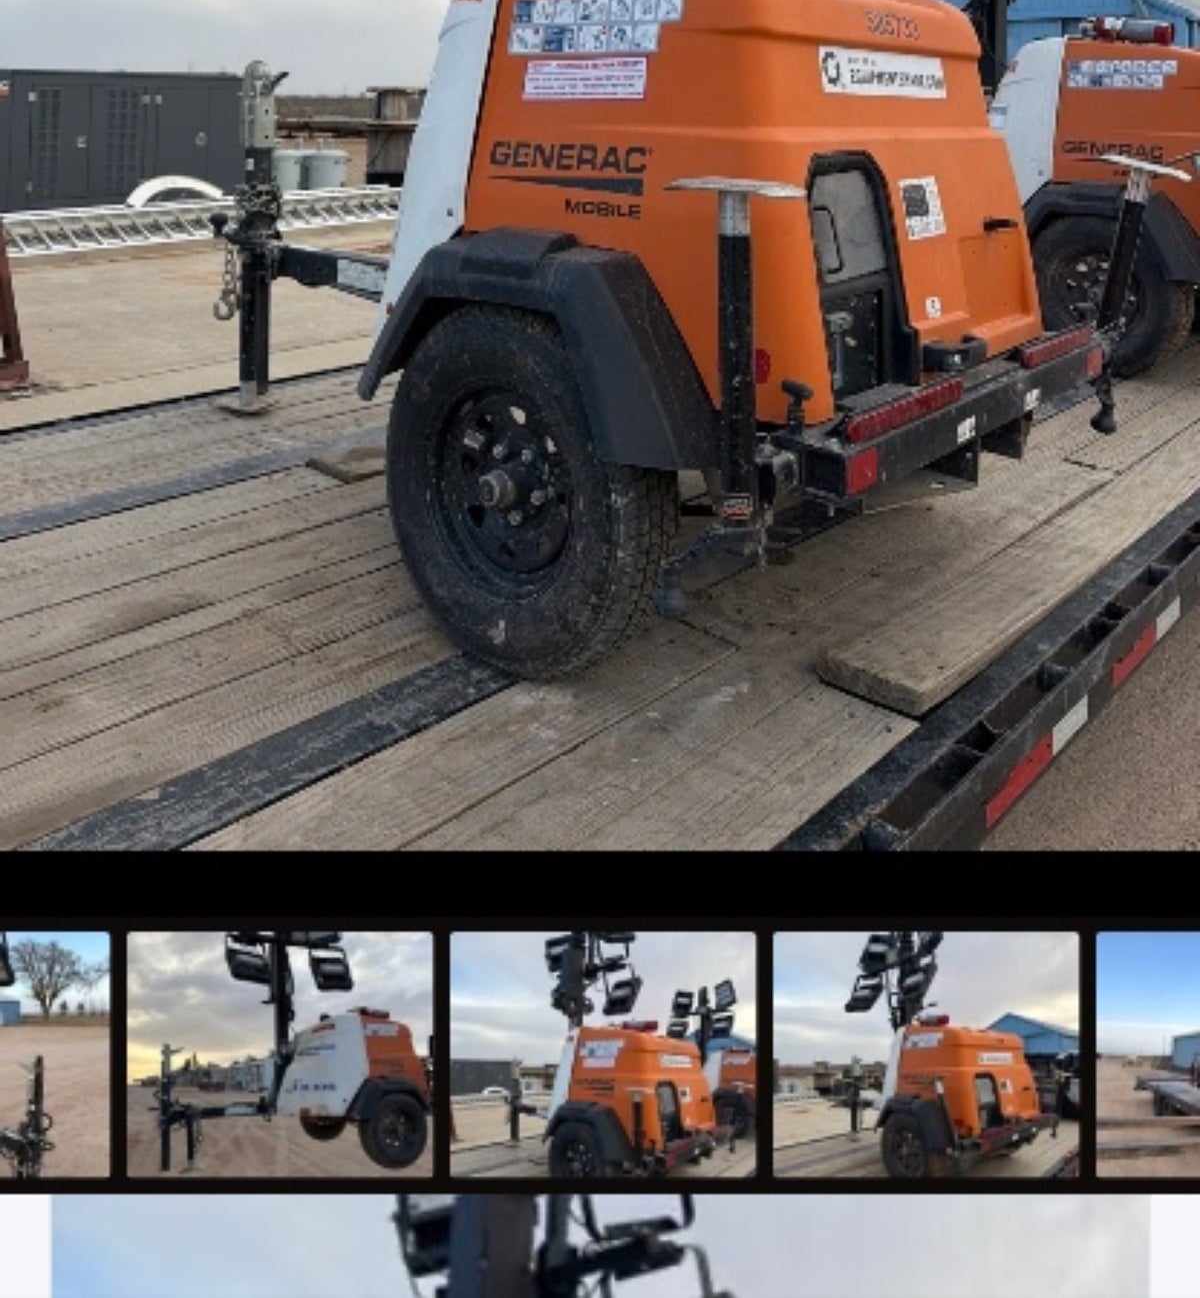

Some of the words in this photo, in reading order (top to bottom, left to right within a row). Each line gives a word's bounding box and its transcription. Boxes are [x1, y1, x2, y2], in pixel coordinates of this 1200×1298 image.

[489, 140, 648, 174] GENERAC
[1062, 141, 1164, 164] GENERAC
[564, 199, 642, 219] MOBILE
